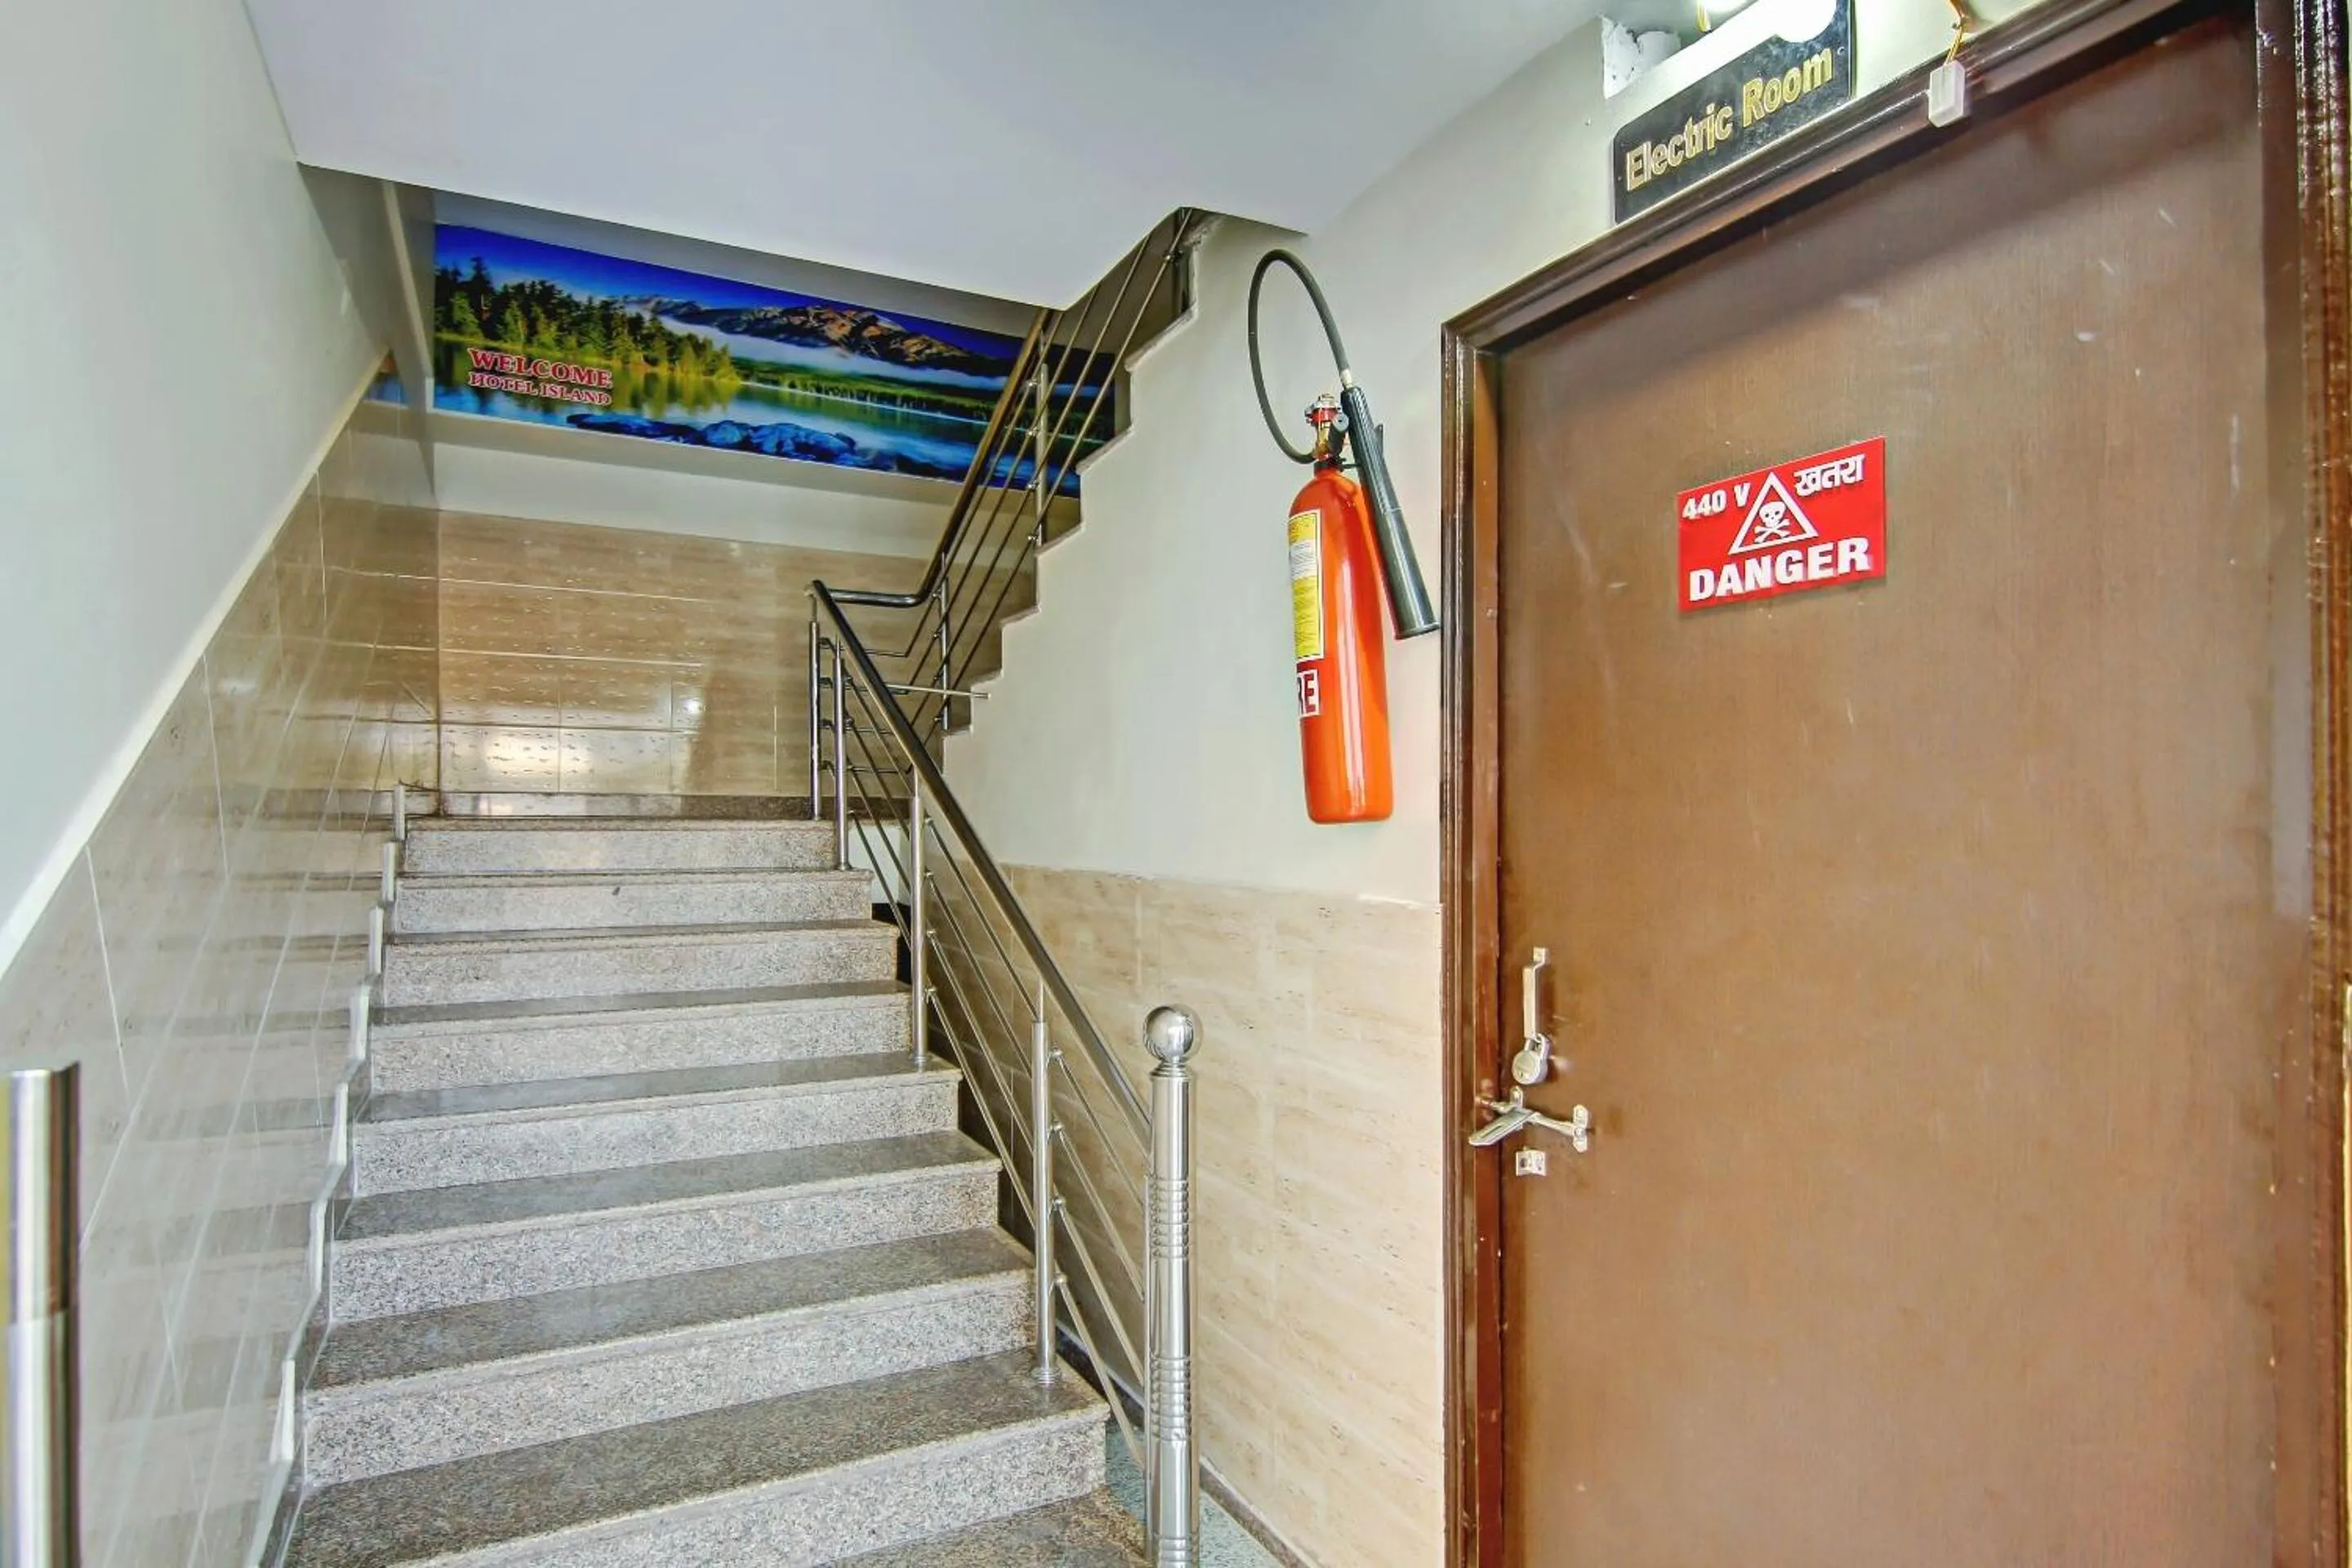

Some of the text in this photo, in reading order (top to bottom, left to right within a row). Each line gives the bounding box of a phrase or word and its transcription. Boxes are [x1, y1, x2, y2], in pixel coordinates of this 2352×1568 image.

[1627, 47, 1833, 191] Electric Room
[468, 348, 612, 388] WELCOME
[469, 371, 612, 405] HOTEL ISLAND
[1793, 454, 1865, 497] खतरा
[1682, 483, 1750, 519] 440 V
[1689, 537, 1871, 601] DANGER
